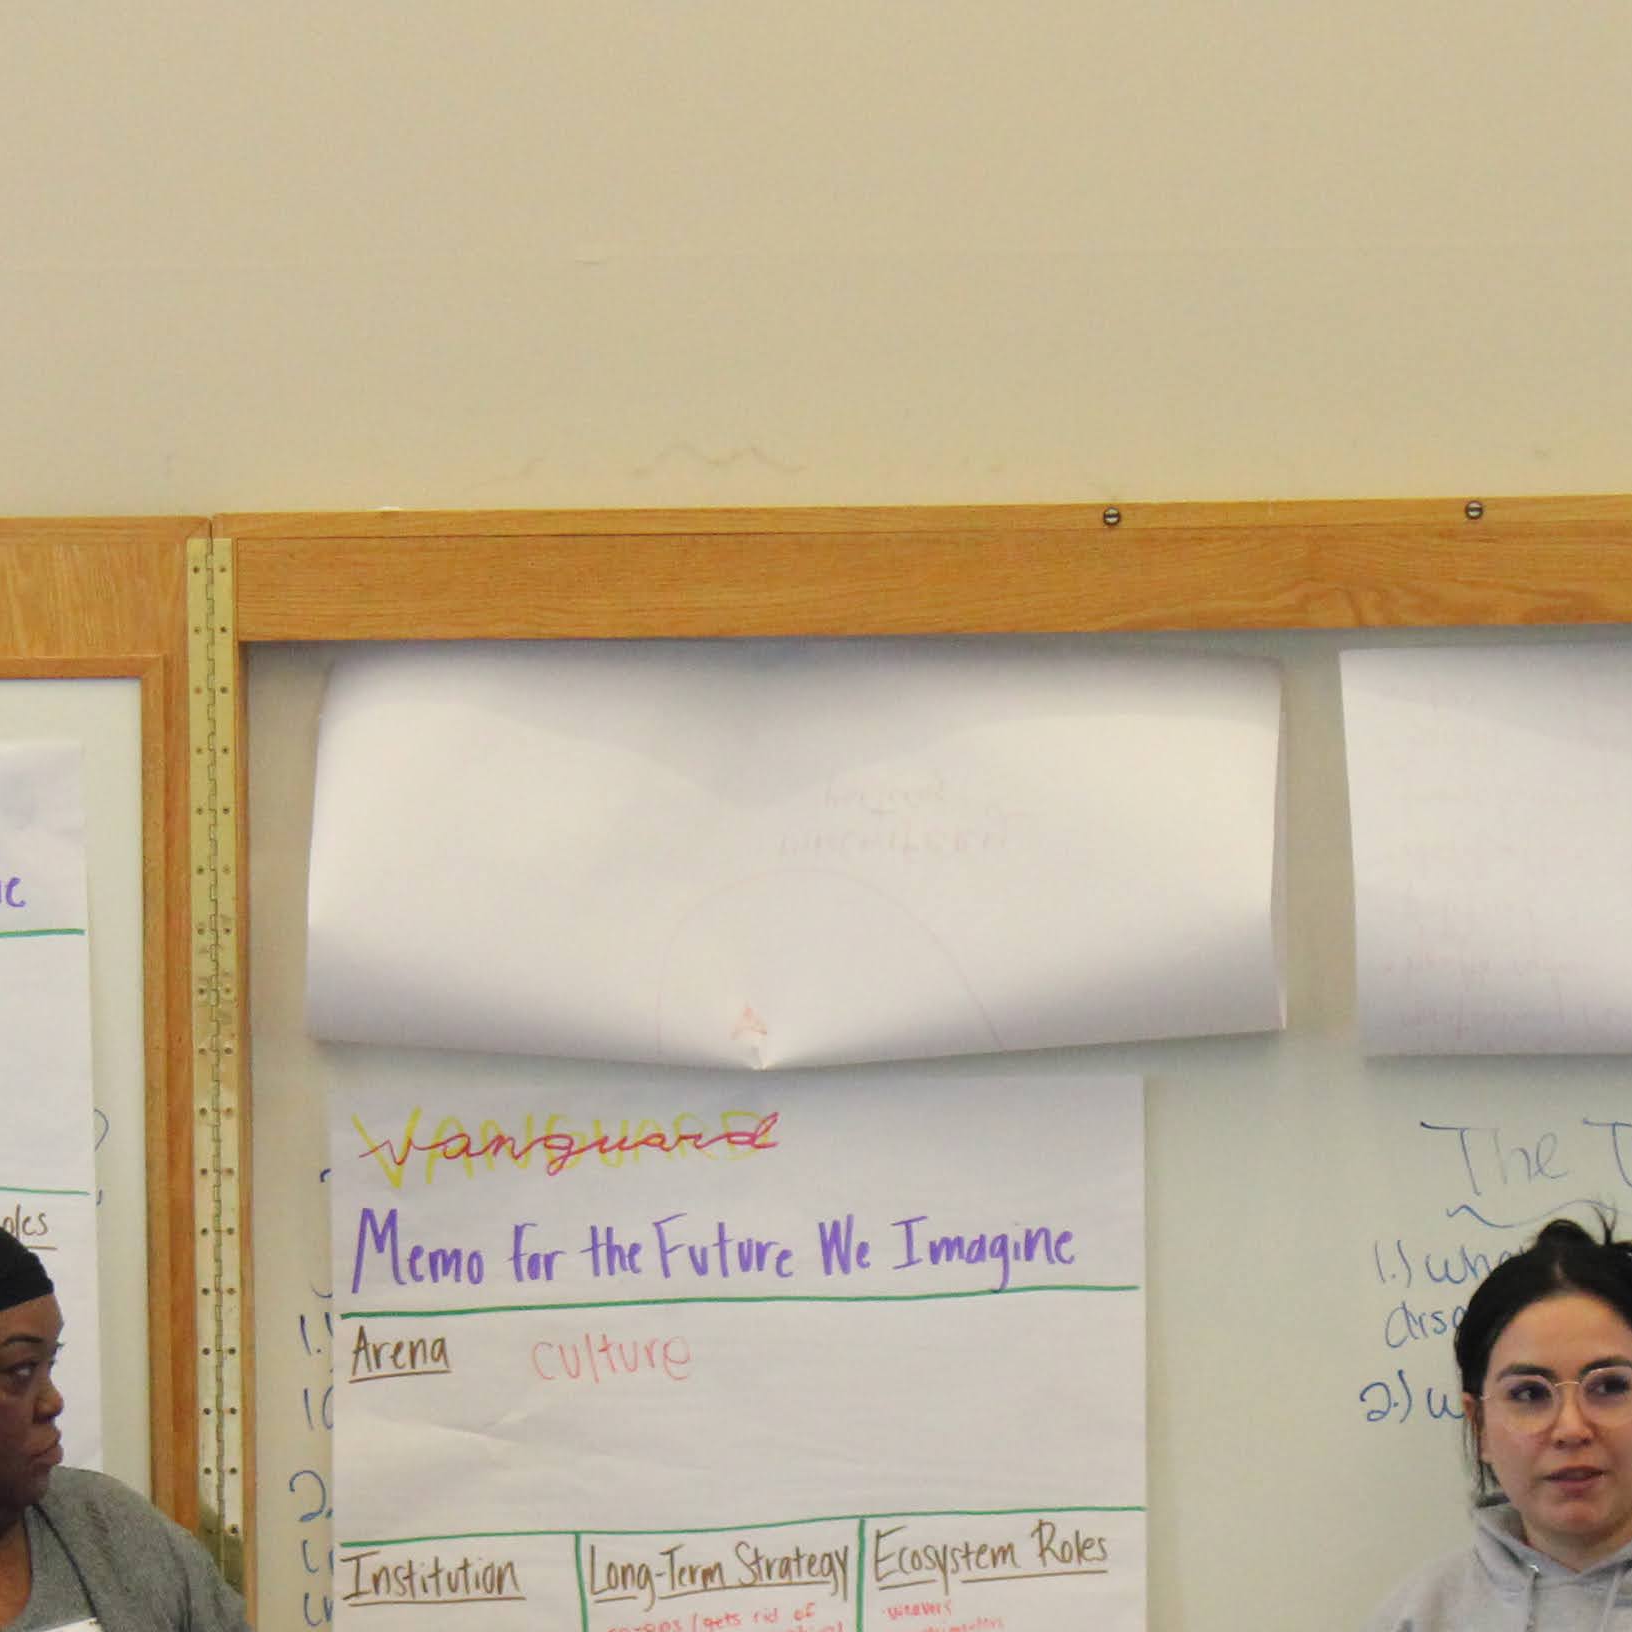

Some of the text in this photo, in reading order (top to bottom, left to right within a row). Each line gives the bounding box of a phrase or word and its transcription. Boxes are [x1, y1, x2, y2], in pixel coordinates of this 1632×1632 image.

[1419, 1120, 1570, 1197] The
[351, 1207, 485, 1295] Memo
[579, 1225, 644, 1279] the
[651, 1212, 796, 1283] Future
[817, 1218, 873, 1277] We
[891, 1214, 1077, 1293] Imagine
[351, 1332, 450, 1377] Arena
[1360, 1368, 1413, 1424] 2.)
[341, 1550, 520, 1598] Institution
[588, 1538, 852, 1611] Long-Term Strategy
[874, 1519, 1109, 1596] Ecosystem Roles
[752, 1607, 779, 1624] rid
